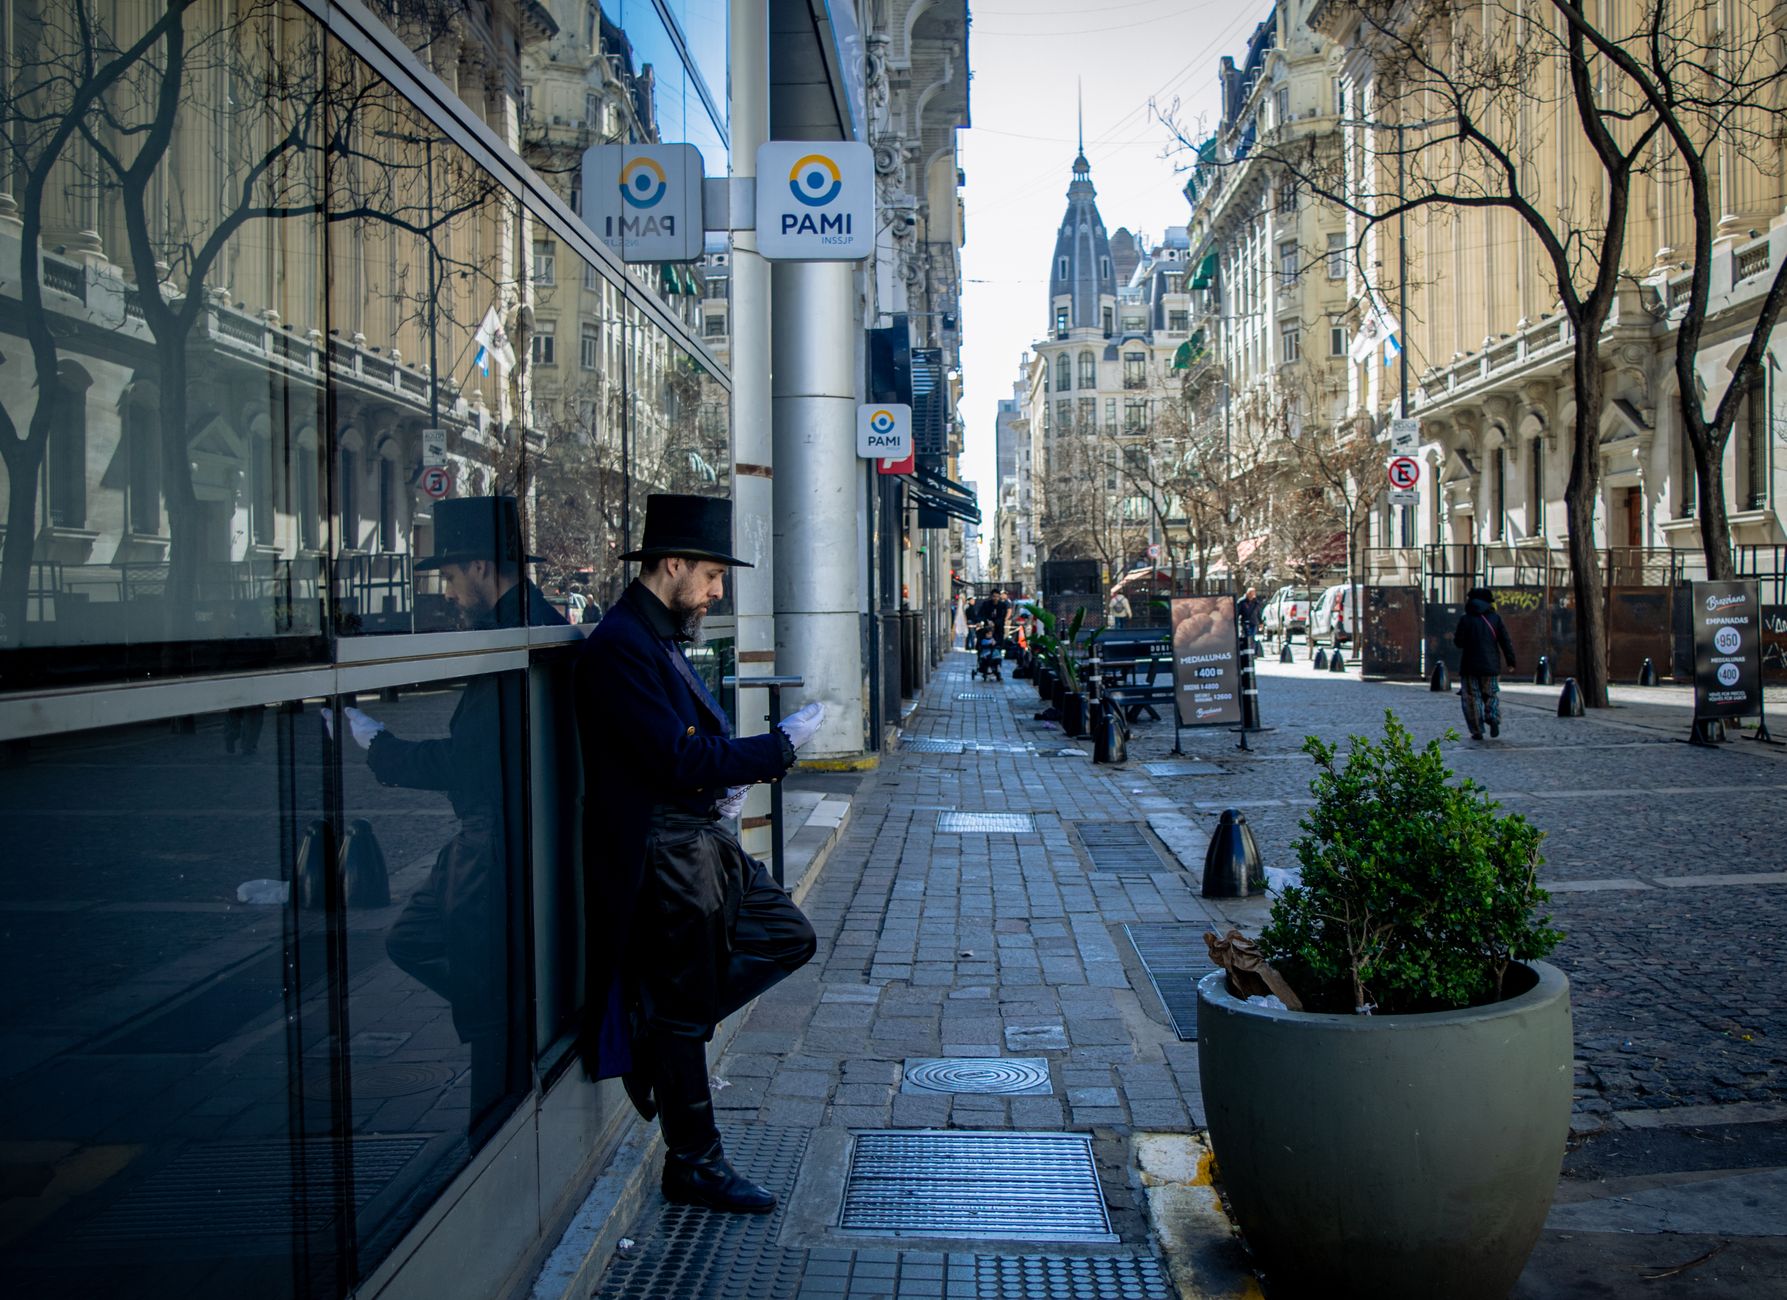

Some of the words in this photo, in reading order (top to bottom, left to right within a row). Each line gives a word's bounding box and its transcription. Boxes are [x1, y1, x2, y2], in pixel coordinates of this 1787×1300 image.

[781, 213, 852, 235] PAMI
[821, 236, 854, 245] INSSJP
[868, 436, 901, 446] PAMI
[1706, 617, 1749, 625] EMPANADAS
[1180, 652, 1232, 665] MEDIALUNAS
